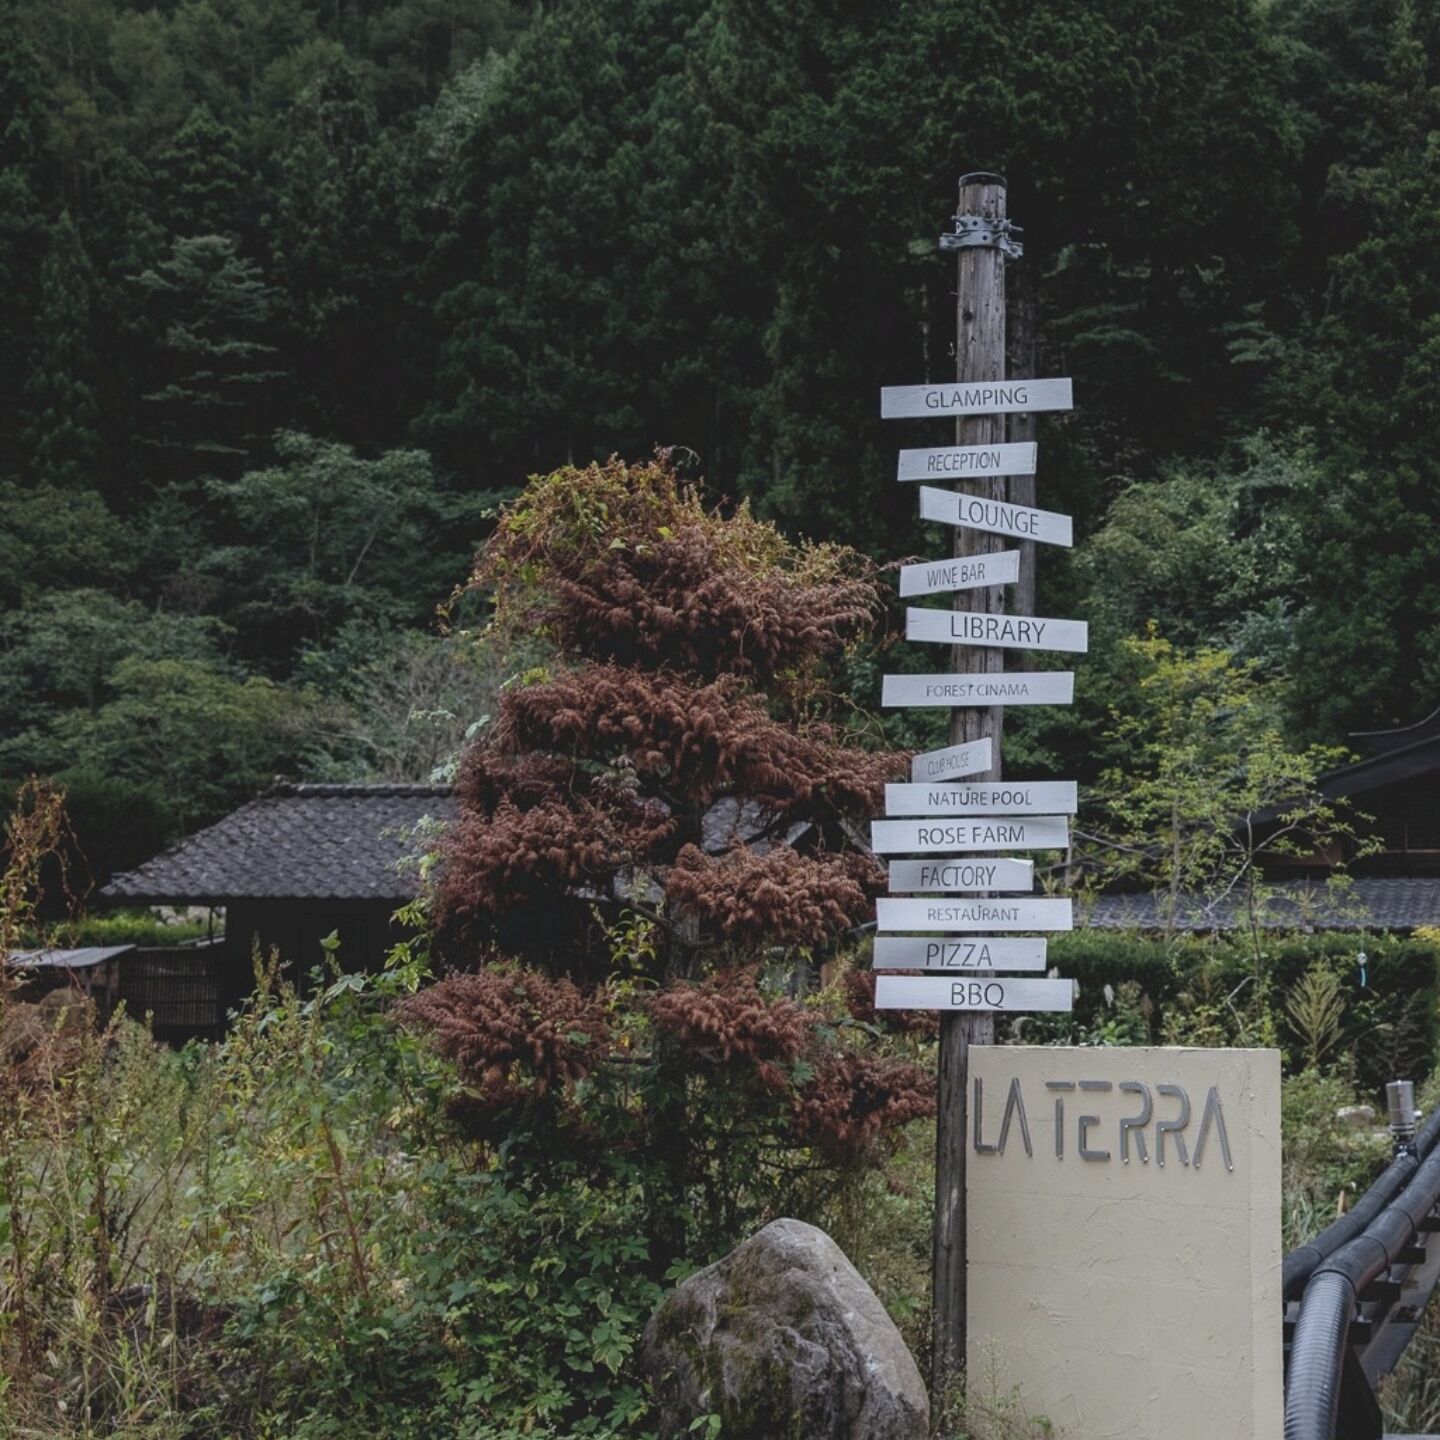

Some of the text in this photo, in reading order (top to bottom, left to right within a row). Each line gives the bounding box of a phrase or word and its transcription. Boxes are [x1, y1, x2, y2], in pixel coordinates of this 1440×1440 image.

[925, 387, 1028, 408] GLAMPING
[927, 452, 1001, 472] RECEPTION
[958, 498, 1040, 535] LOUNGE
[927, 562, 986, 587] WINE BAR
[951, 615, 1046, 643] LIBRARY
[926, 683, 1029, 698] FOREST CINAMA
[928, 790, 1033, 806] NATURE POOL
[918, 825, 1025, 845] ROSE FARM
[920, 866, 997, 887] FACTORY
[927, 907, 1020, 921] RESTAURANT
[926, 943, 992, 968] PIZZA
[951, 982, 1005, 1008] BBQ
[973, 1077, 1235, 1172] LA TERRA
